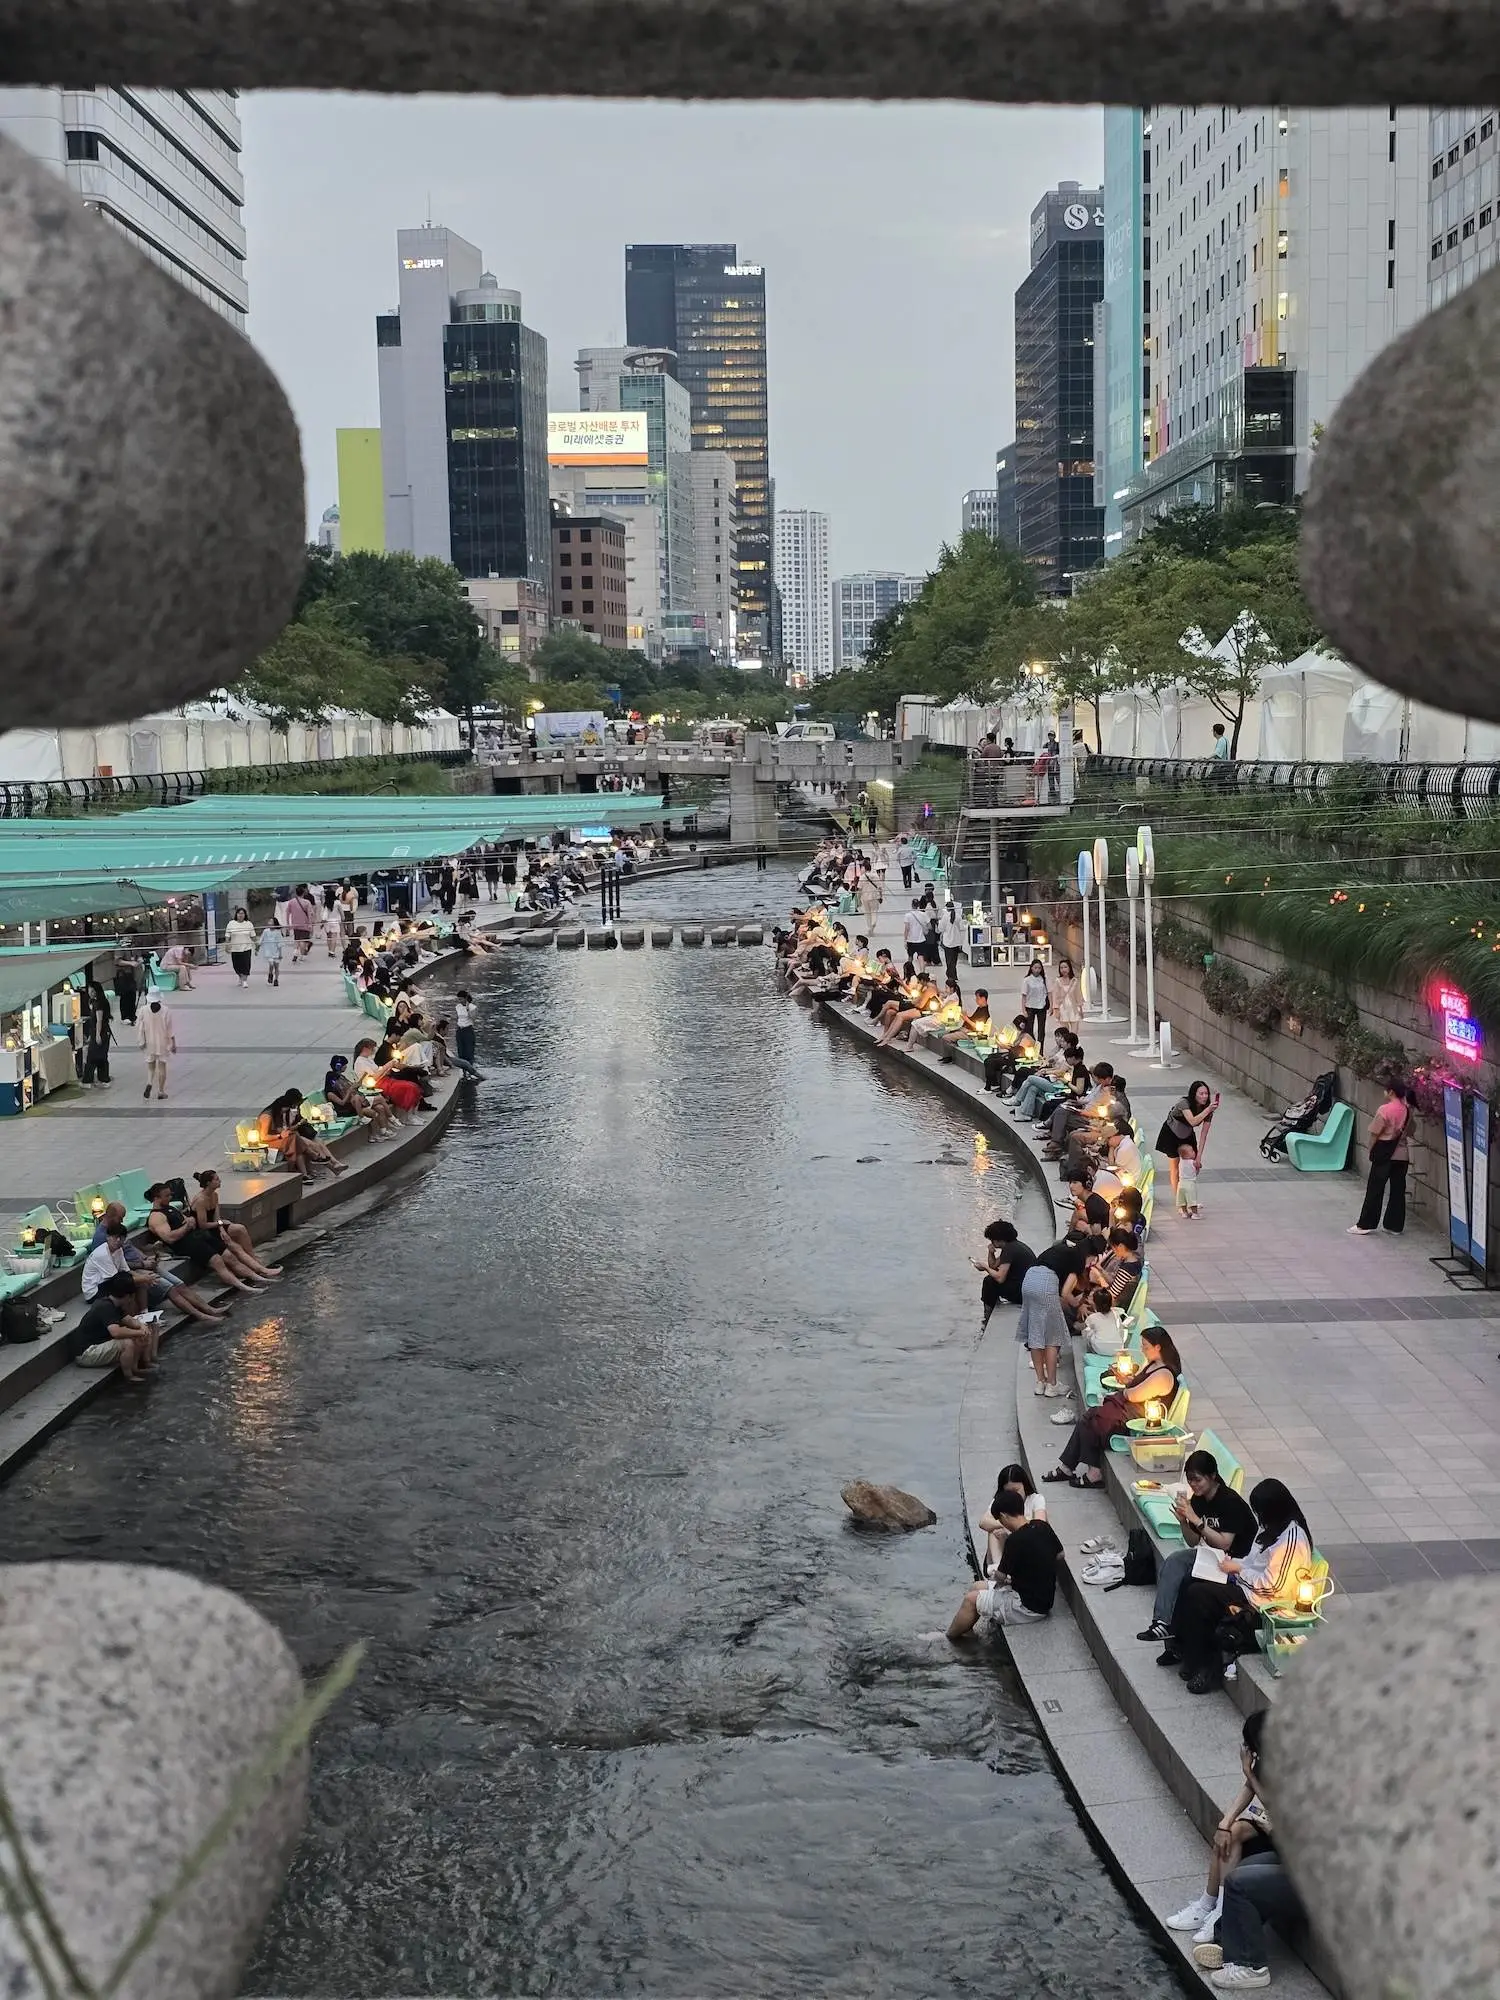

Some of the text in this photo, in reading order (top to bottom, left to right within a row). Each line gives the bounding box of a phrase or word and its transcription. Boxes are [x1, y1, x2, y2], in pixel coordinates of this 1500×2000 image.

[547, 420, 640, 433] 글로벌 자산배분 투자
[563, 434, 625, 445] 미래에셋증권
